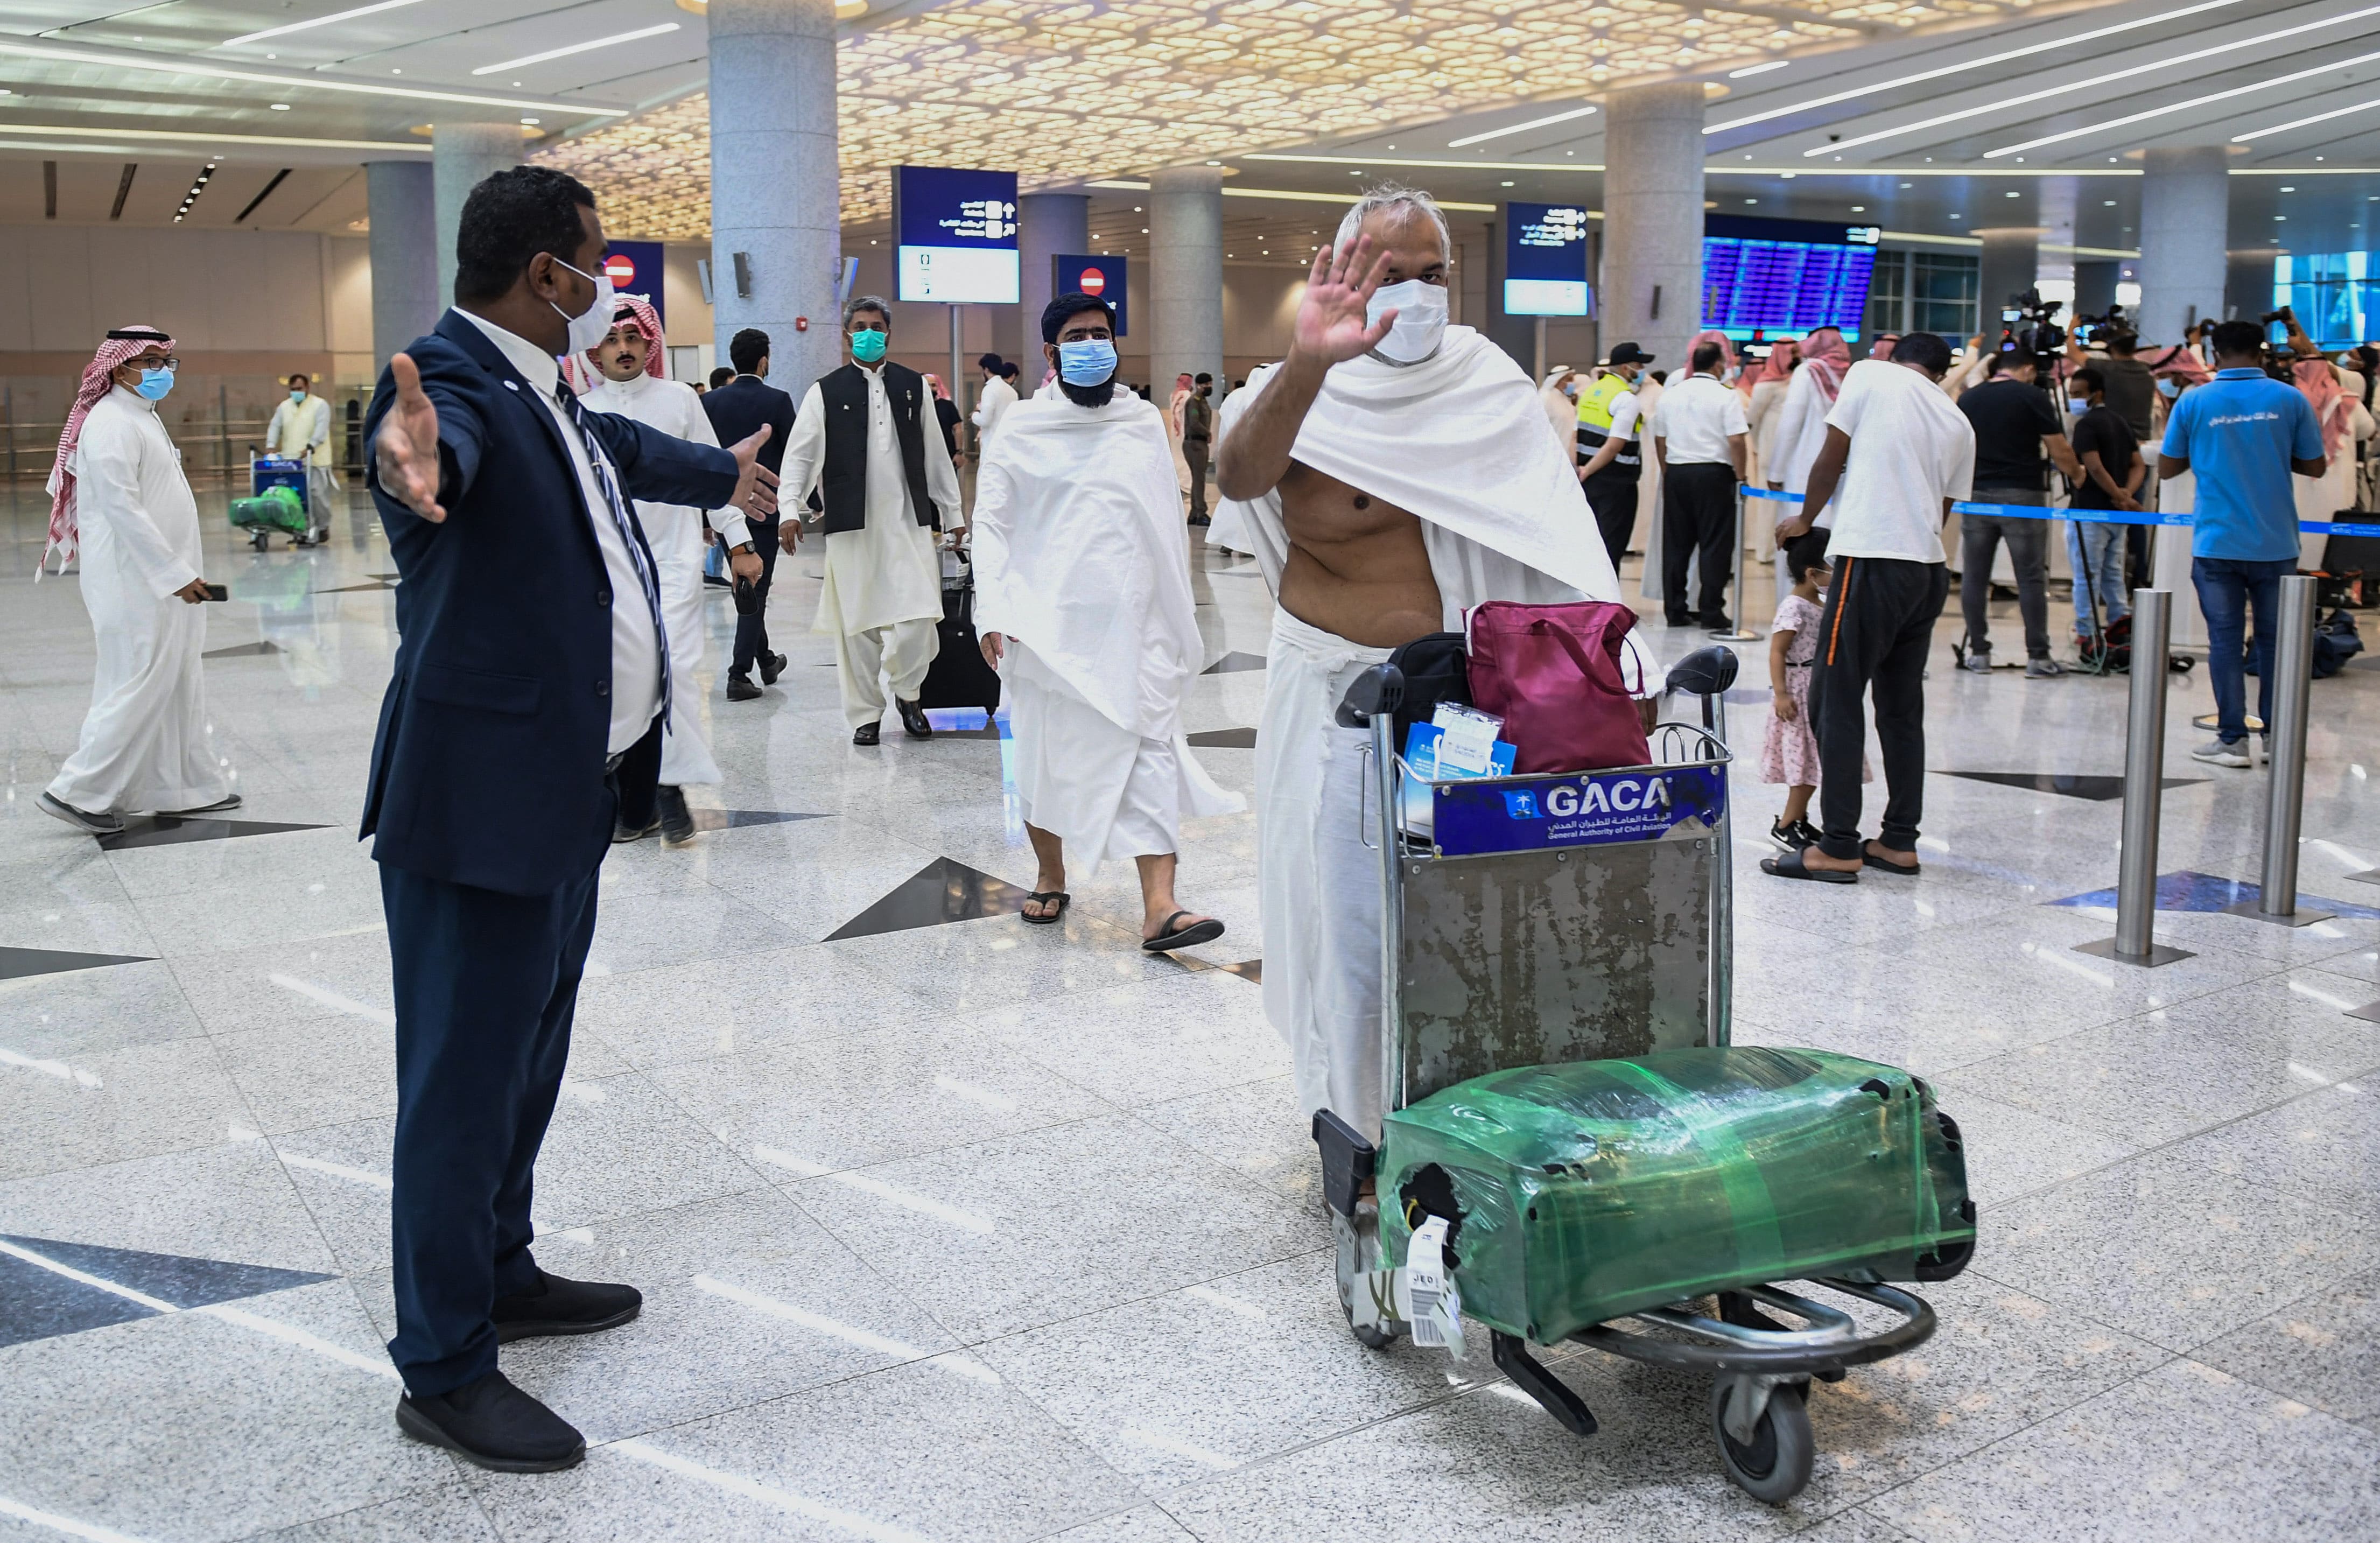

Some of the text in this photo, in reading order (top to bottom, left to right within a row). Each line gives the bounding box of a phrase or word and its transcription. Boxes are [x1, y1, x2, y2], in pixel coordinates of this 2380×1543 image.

[1547, 777, 1671, 817] GACA
[1578, 818, 1610, 829] للطيران
[1548, 830, 1577, 840] General
[1579, 828, 1613, 837] Authority
[1624, 825, 1640, 833] Civil
[1642, 823, 1671, 831] Aviation
[1413, 1274, 1433, 1283] JED
